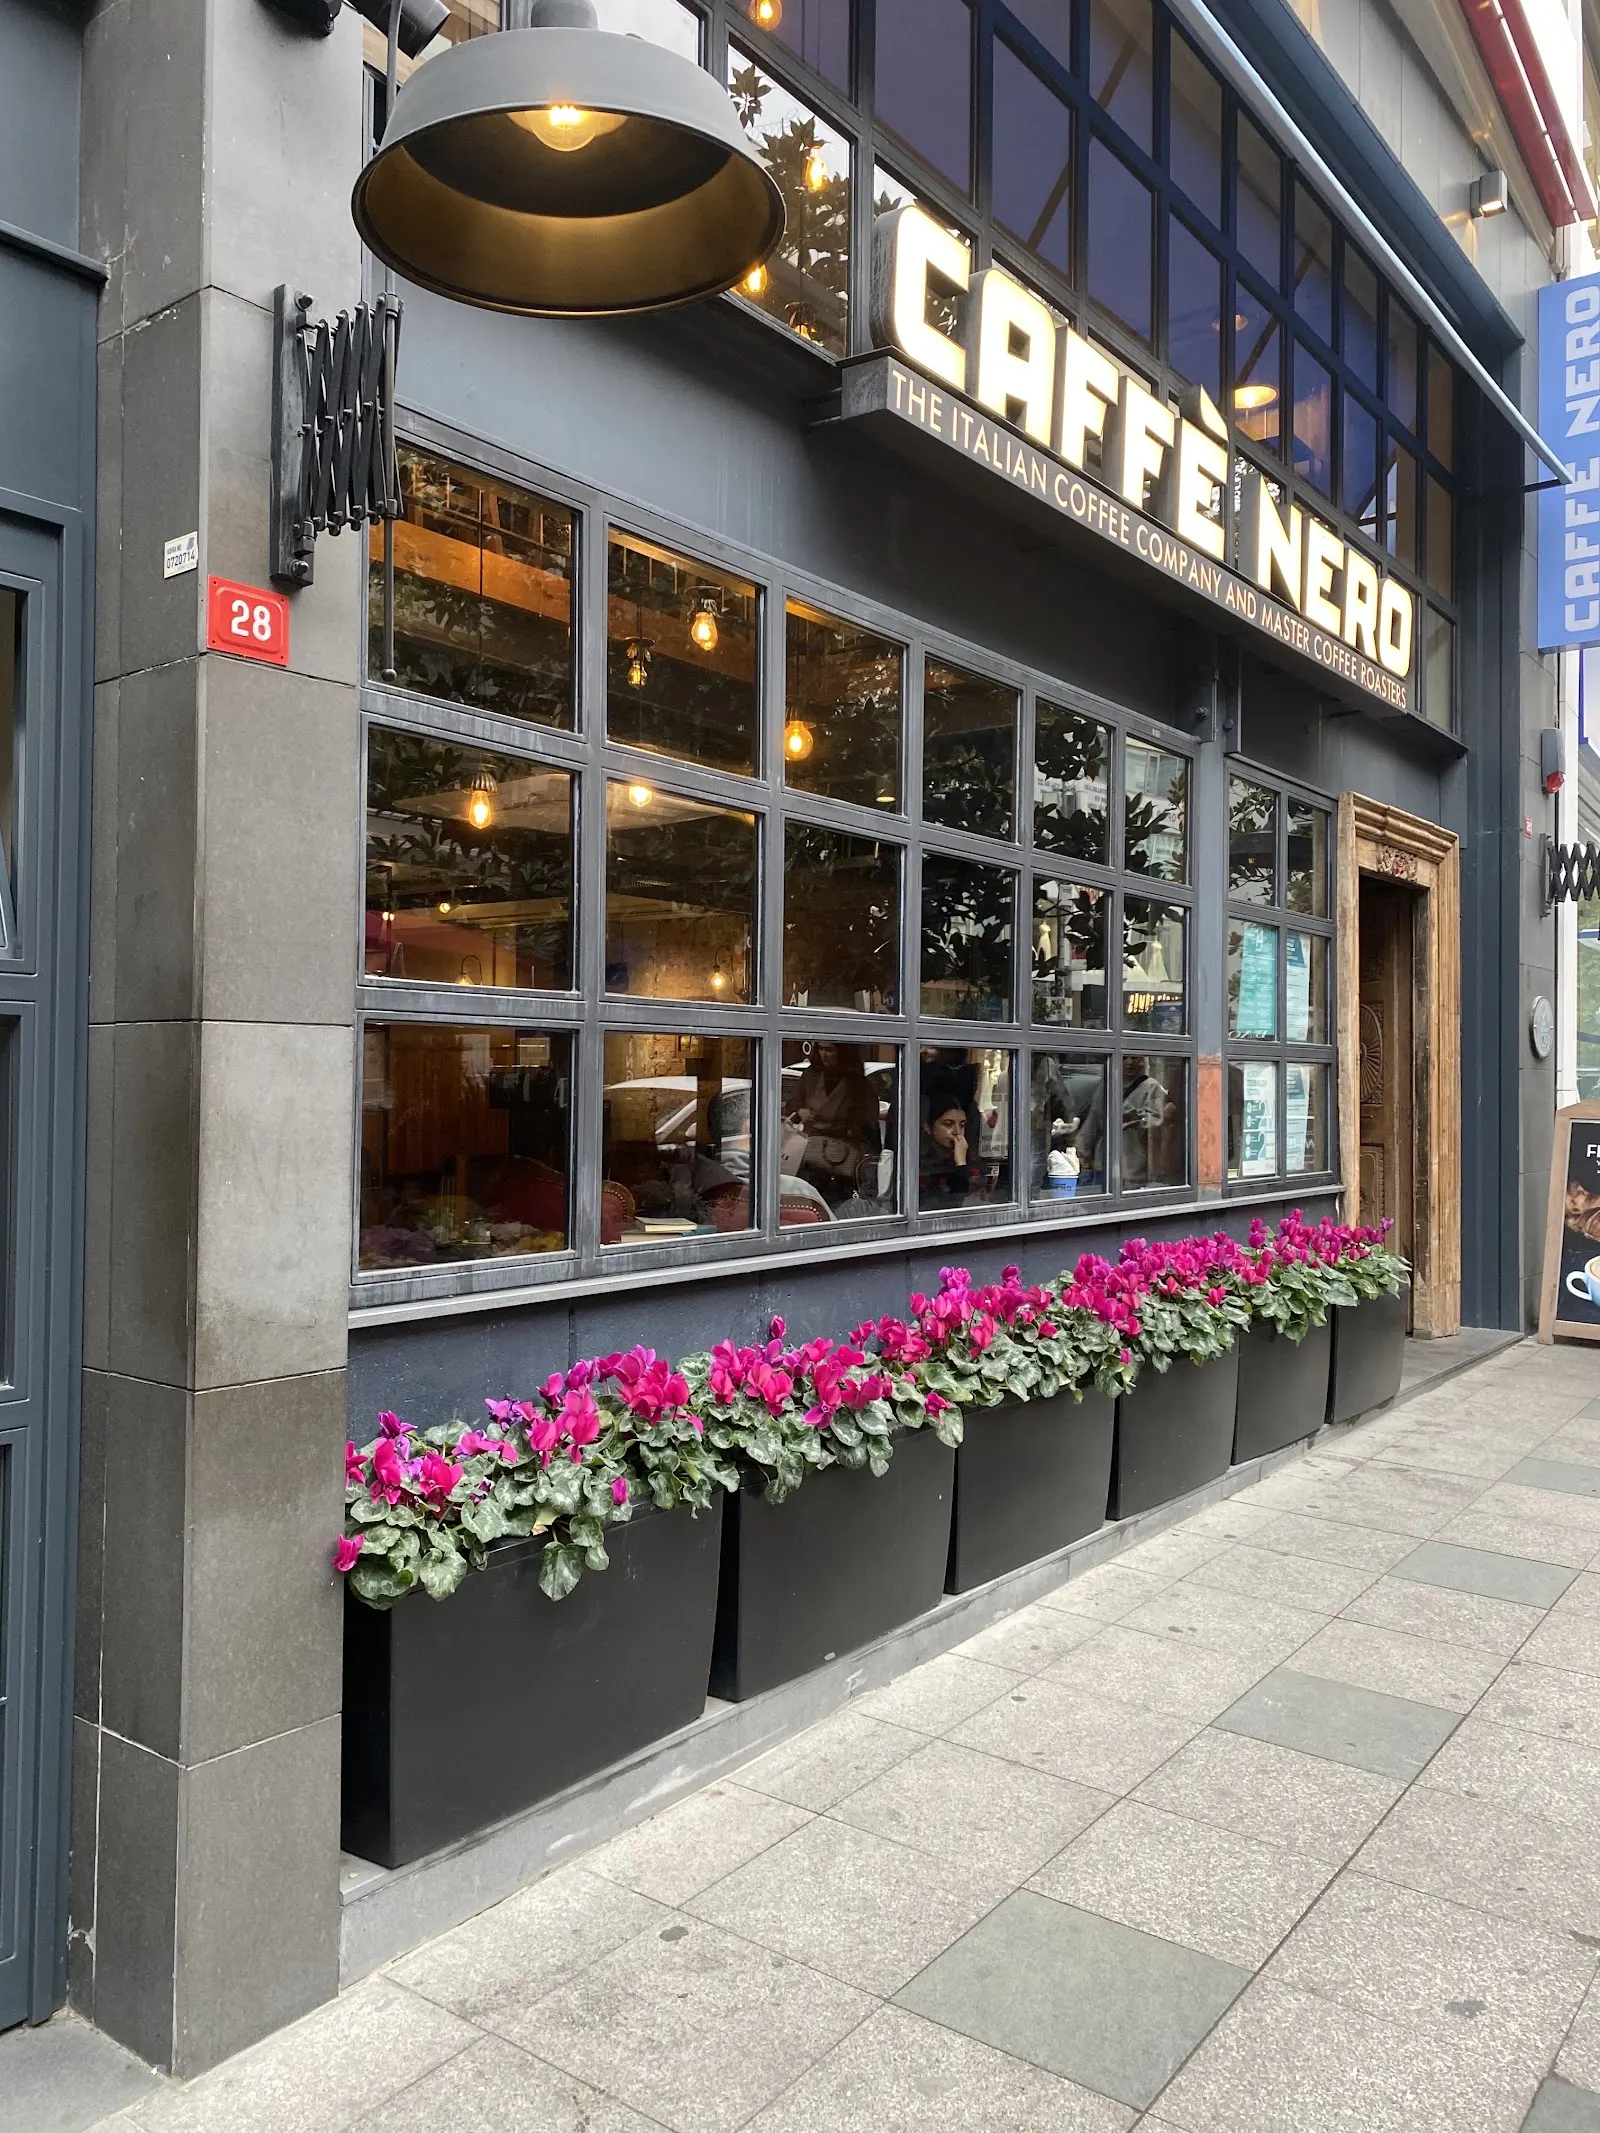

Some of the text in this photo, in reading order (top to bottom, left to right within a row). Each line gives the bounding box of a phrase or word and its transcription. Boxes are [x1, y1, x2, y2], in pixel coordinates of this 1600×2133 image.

[1565, 285, 1600, 438] NERO
[888, 205, 1413, 678] CAFFÈ NERO
[166, 549, 195, 569] 0720714
[892, 369, 1407, 709] THE ITALIAN COFFEE COMPANY AND MASTER COFFEE ROASTERS
[231, 599, 272, 642] 28
